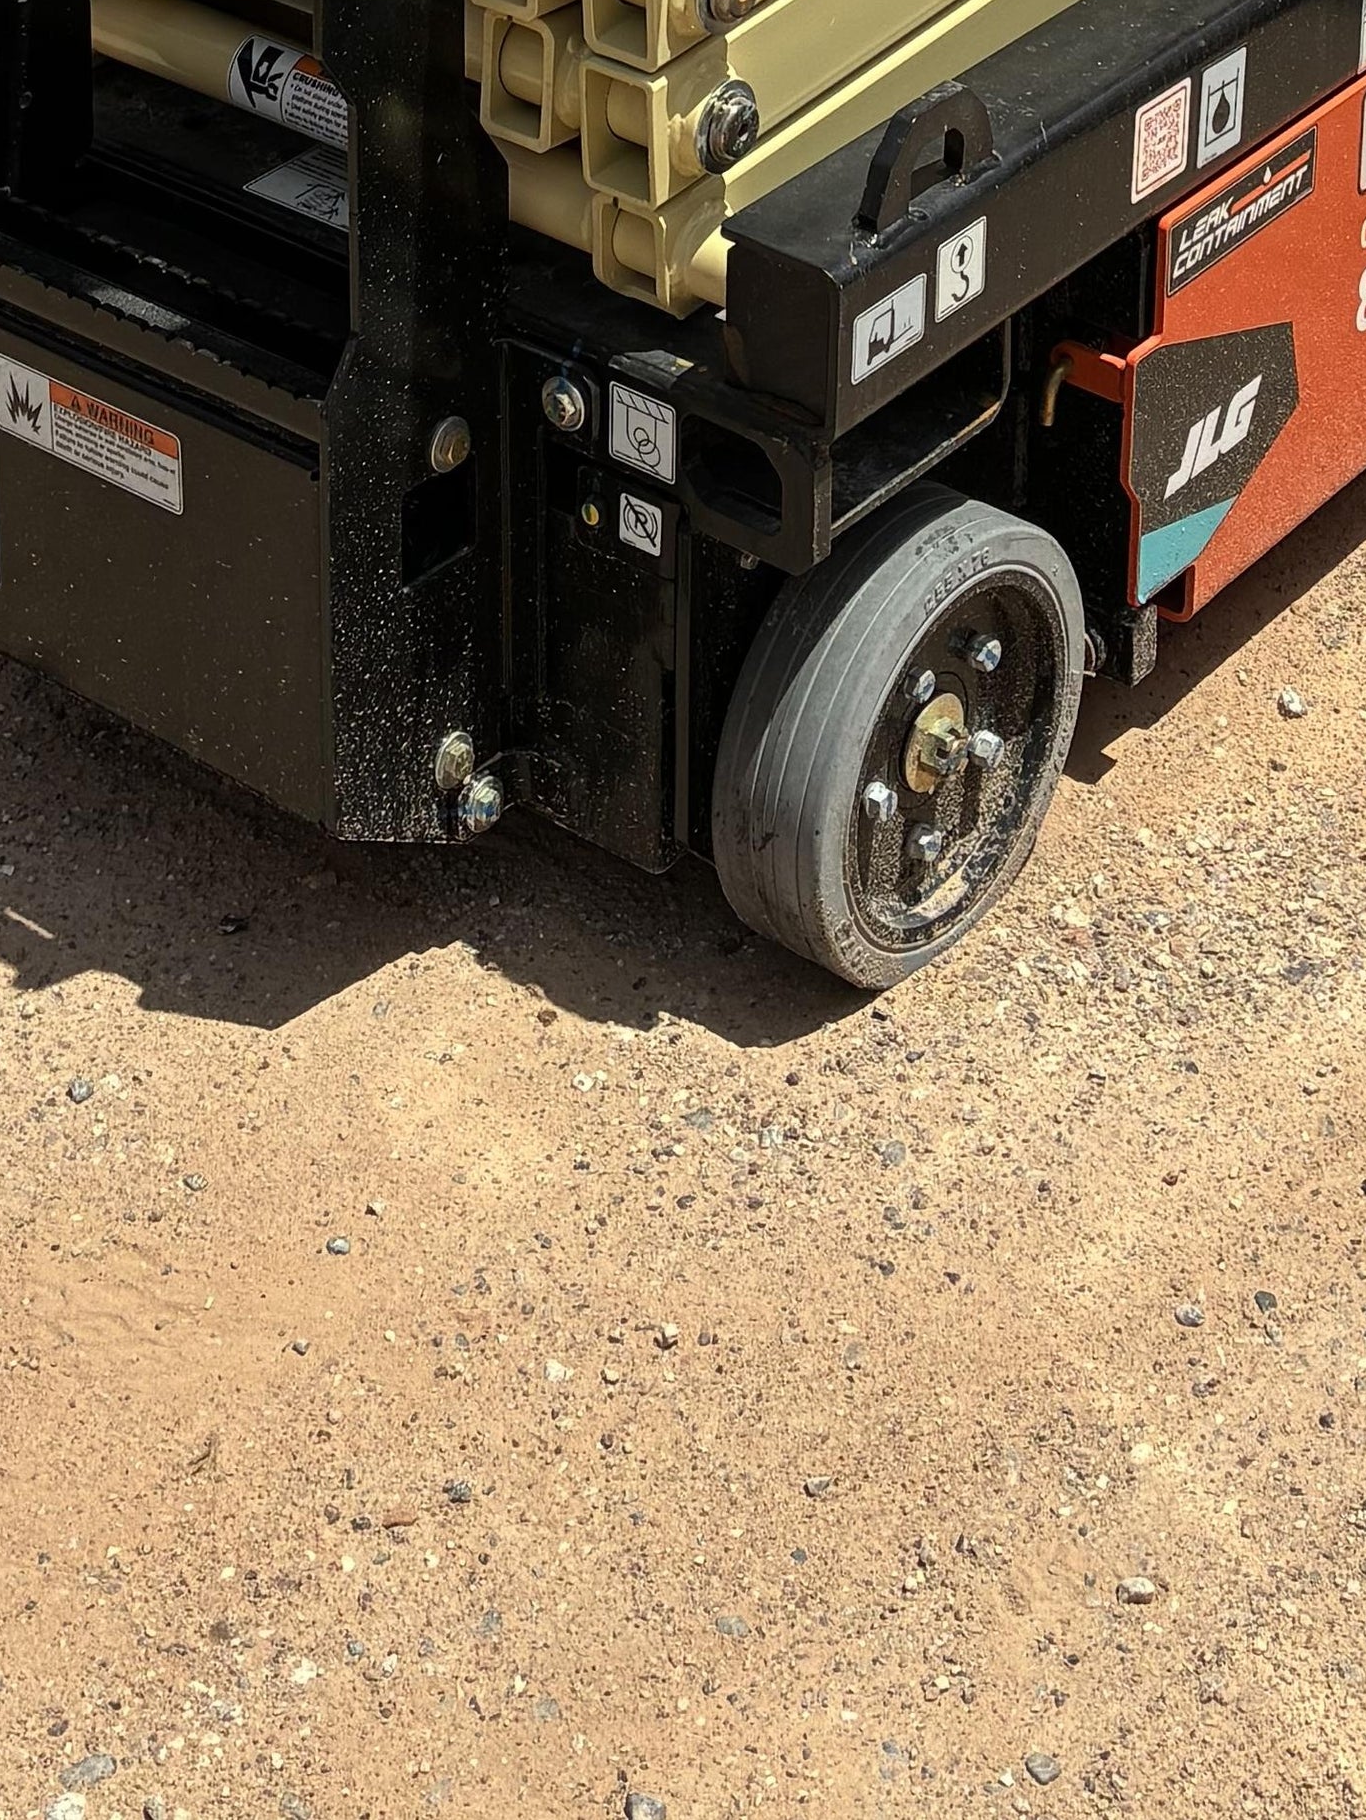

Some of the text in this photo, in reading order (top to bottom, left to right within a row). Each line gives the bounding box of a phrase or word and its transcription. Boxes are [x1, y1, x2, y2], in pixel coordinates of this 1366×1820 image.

[1173, 164, 1309, 280] CONTAINMENT
[1179, 195, 1235, 253] LEAK
[87, 402, 154, 445] WARNING
[1164, 373, 1263, 500] JLG
